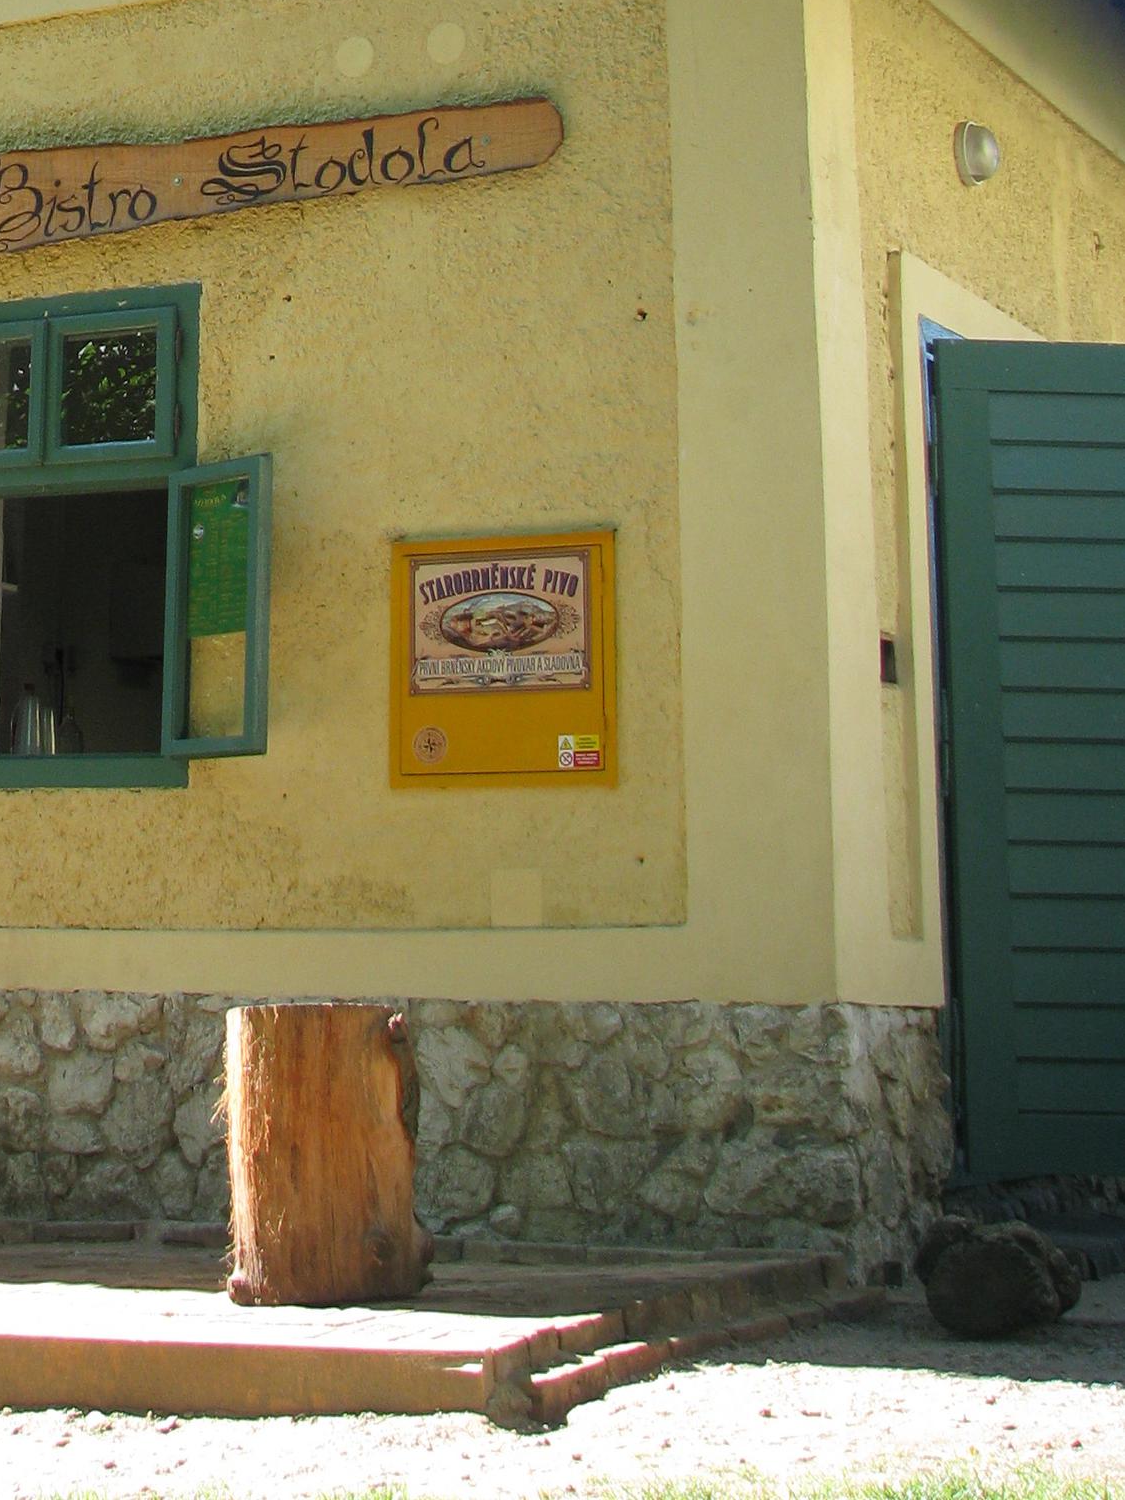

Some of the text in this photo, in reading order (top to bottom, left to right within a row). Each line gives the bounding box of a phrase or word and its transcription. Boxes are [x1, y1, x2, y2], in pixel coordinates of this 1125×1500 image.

[201, 117, 486, 205] Stodola
[419, 563, 579, 605] STAROBRNĚNSKÉ PIVO
